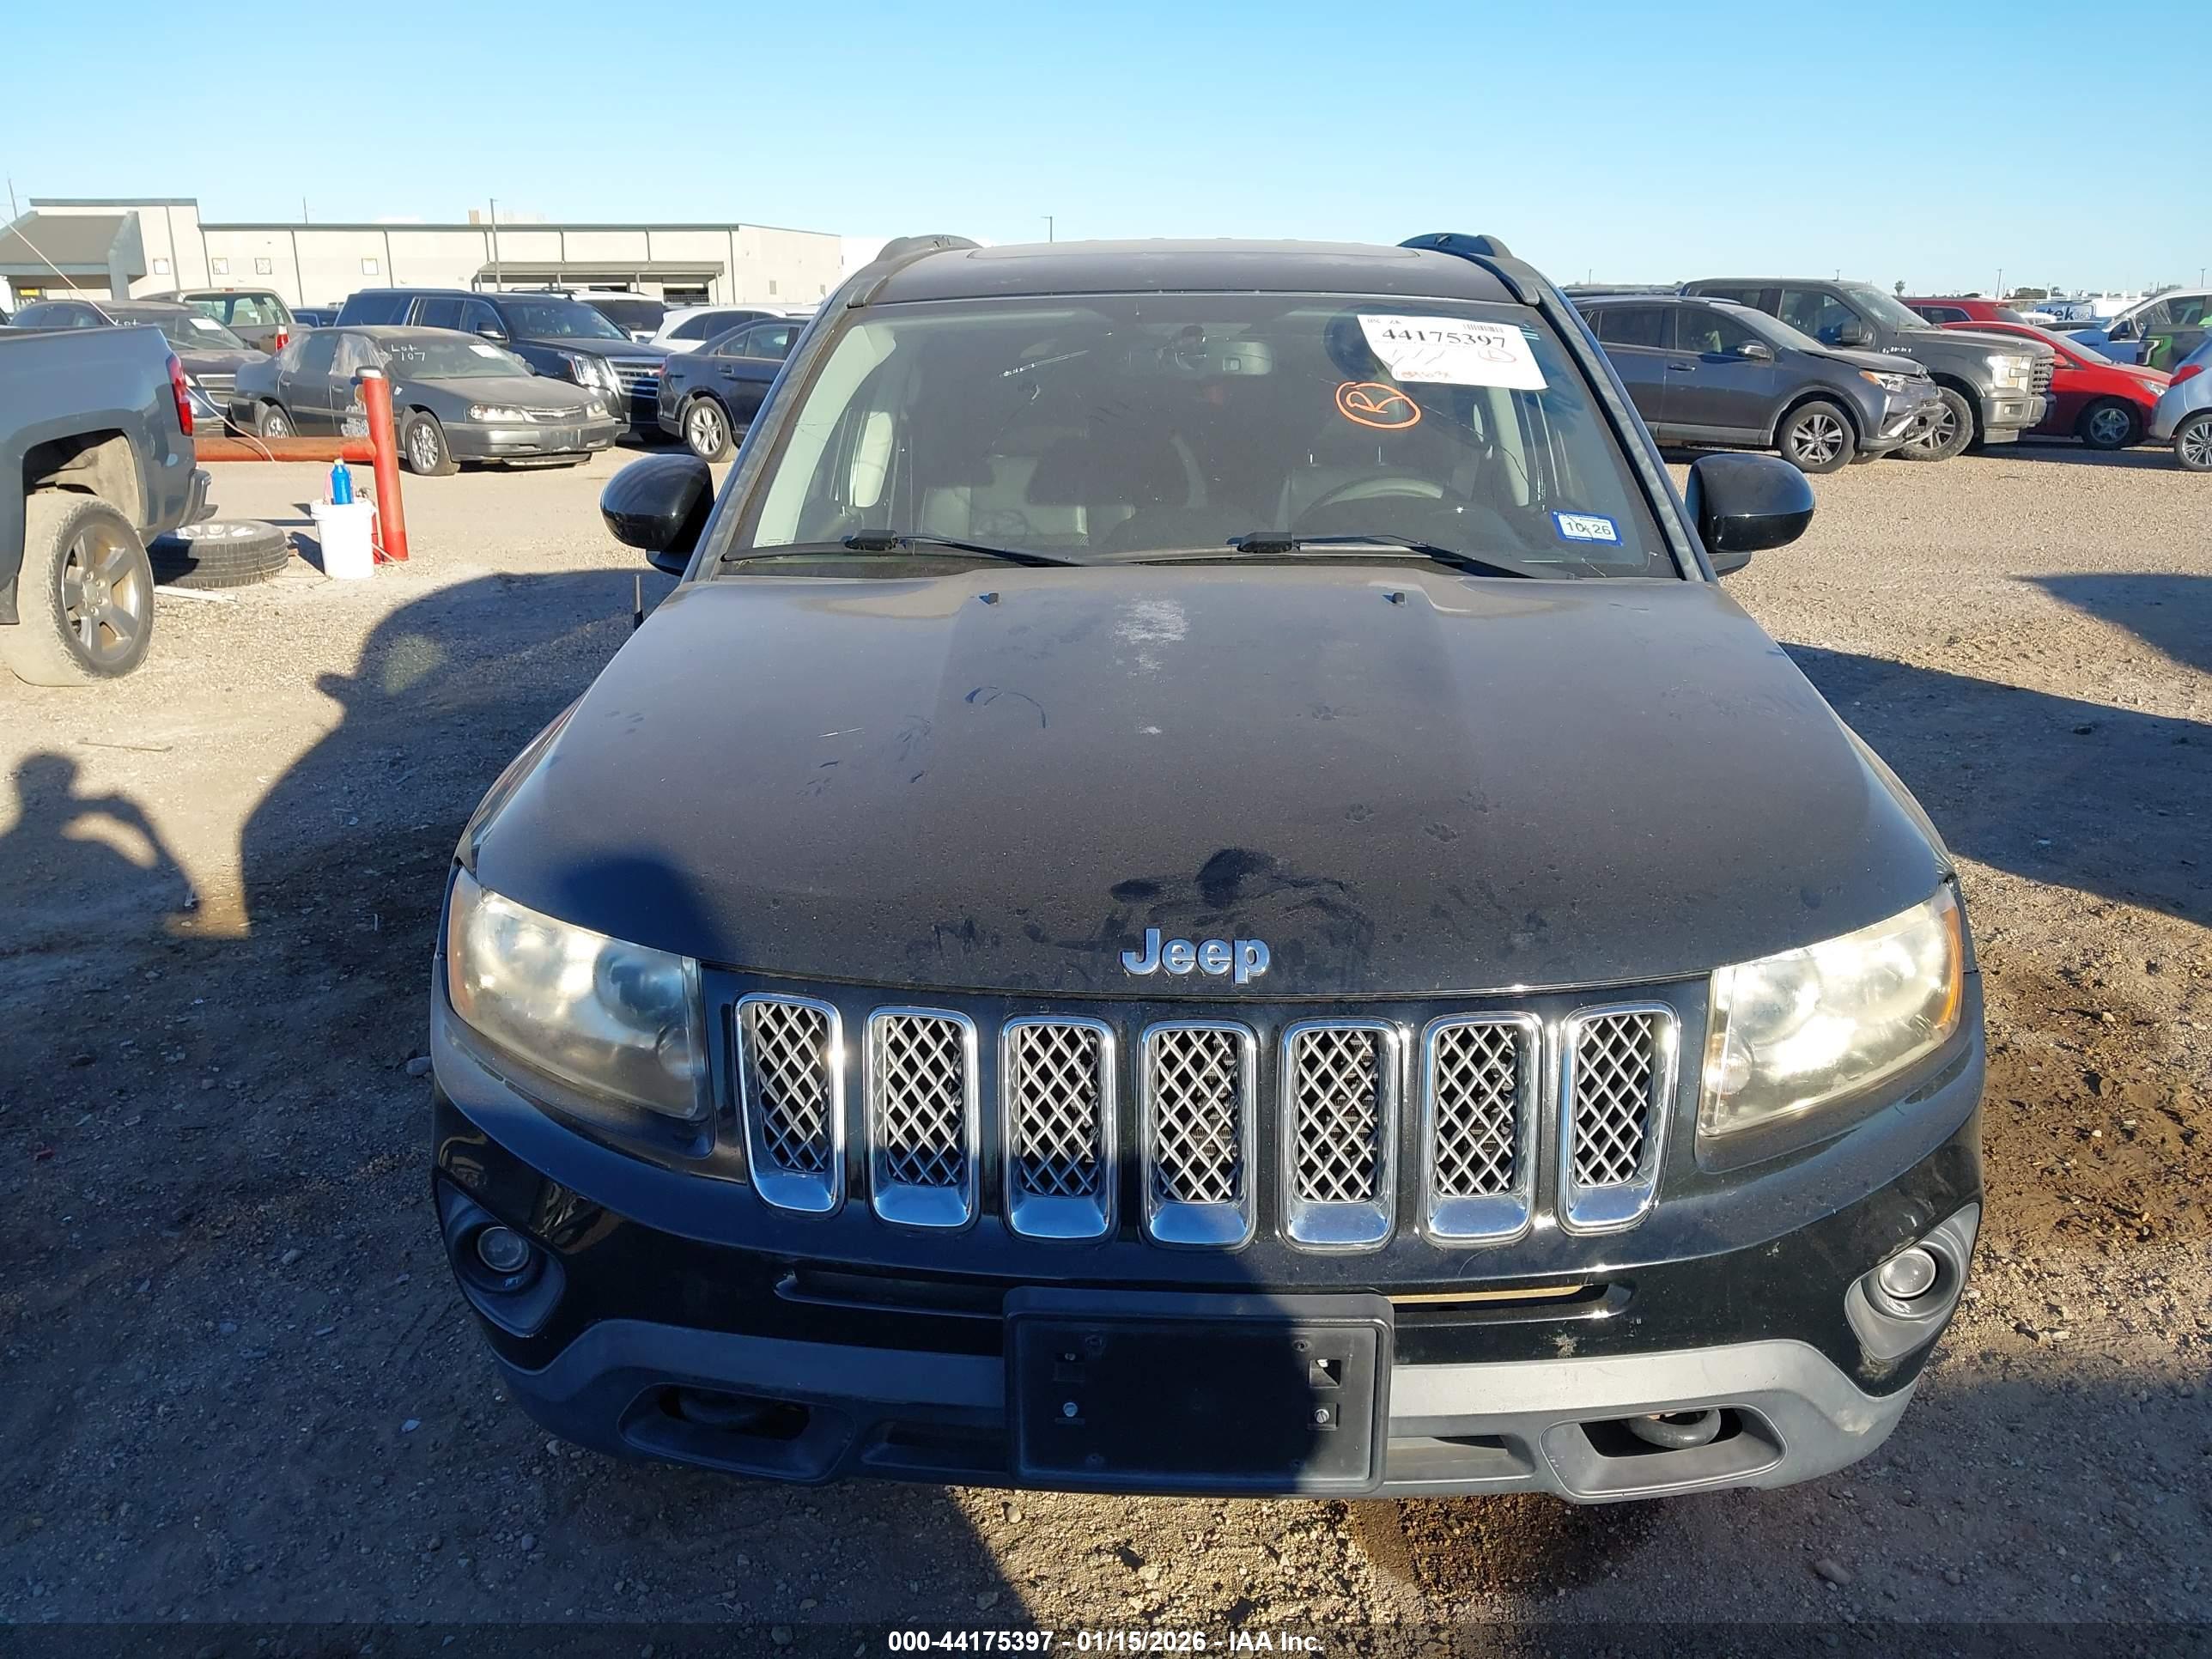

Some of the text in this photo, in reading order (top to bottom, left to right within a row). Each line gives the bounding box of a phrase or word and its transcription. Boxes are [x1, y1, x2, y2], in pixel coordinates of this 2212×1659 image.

[1382, 328, 1505, 348] 44175397
[391, 343, 417, 352] Lot
[401, 352, 425, 362] 107
[1566, 522, 1612, 535] 10 26
[1121, 928, 1270, 985] Jeep
